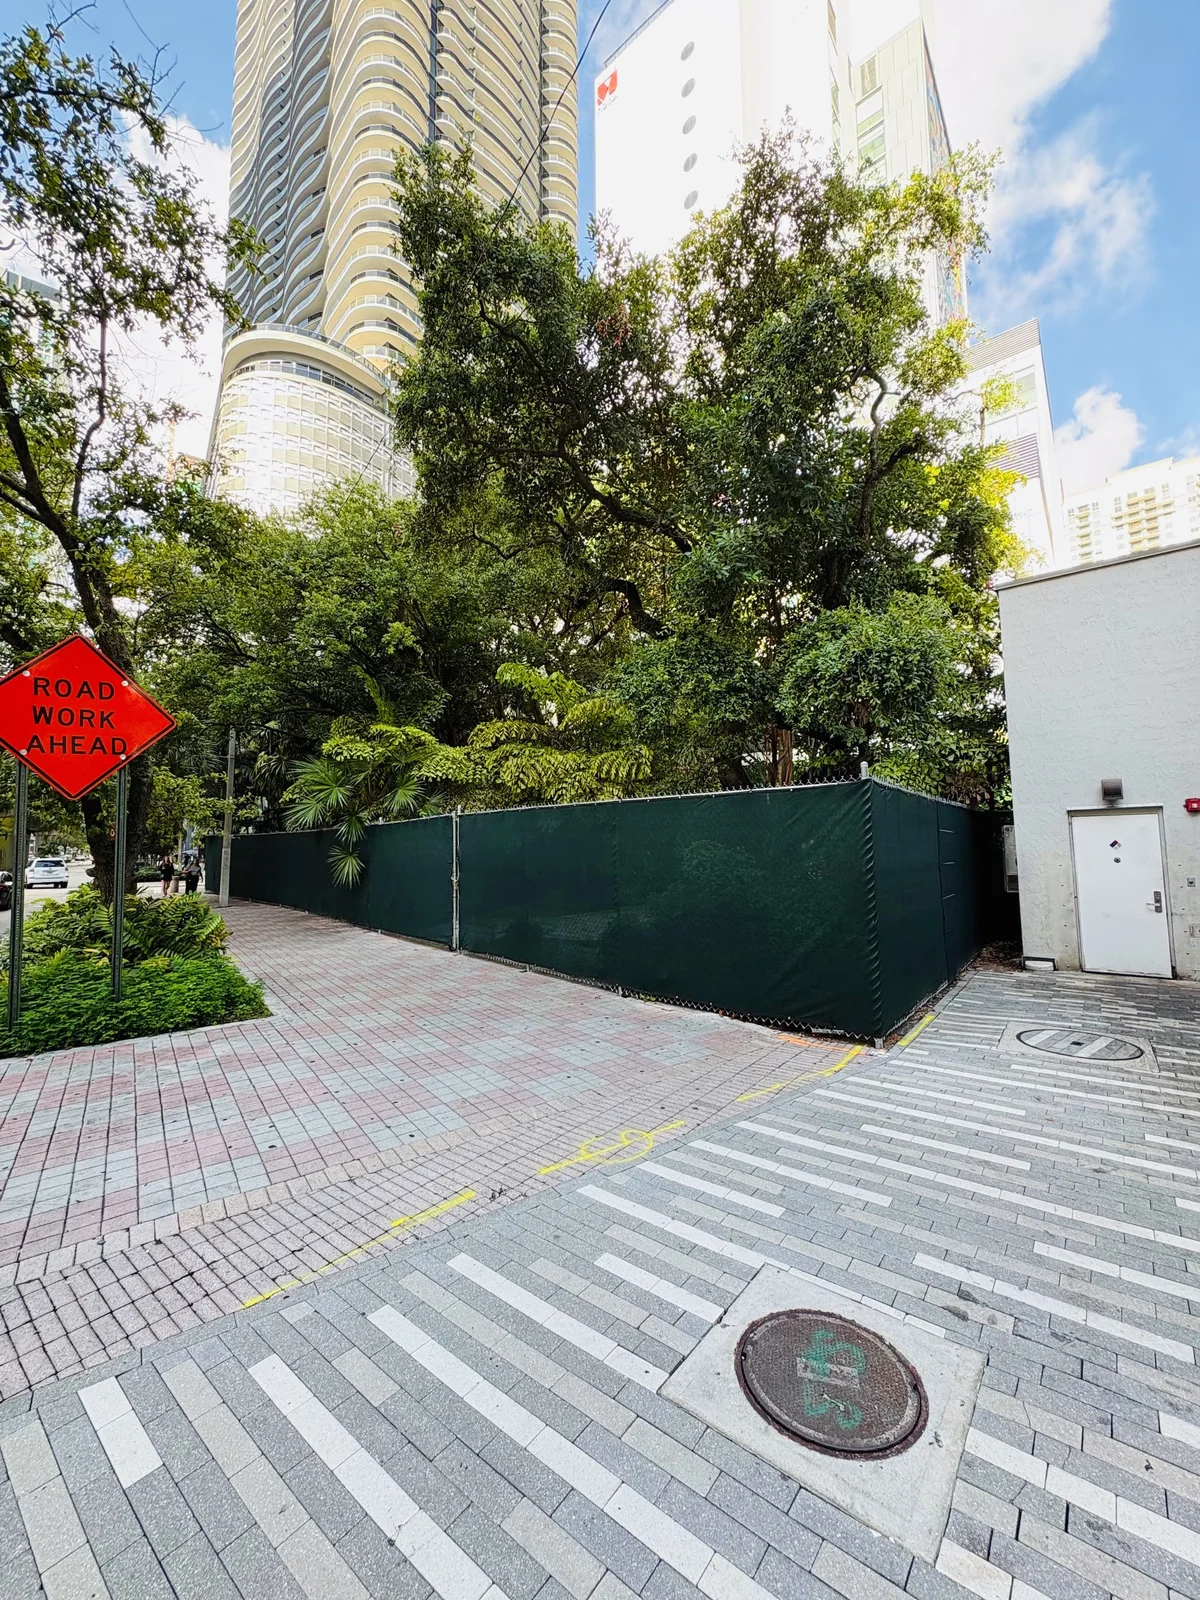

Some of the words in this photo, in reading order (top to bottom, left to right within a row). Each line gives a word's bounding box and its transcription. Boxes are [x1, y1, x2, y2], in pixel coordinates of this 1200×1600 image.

[33, 677, 115, 700] ROAD
[32, 705, 116, 729] WORK
[27, 735, 127, 755] AHEAD
